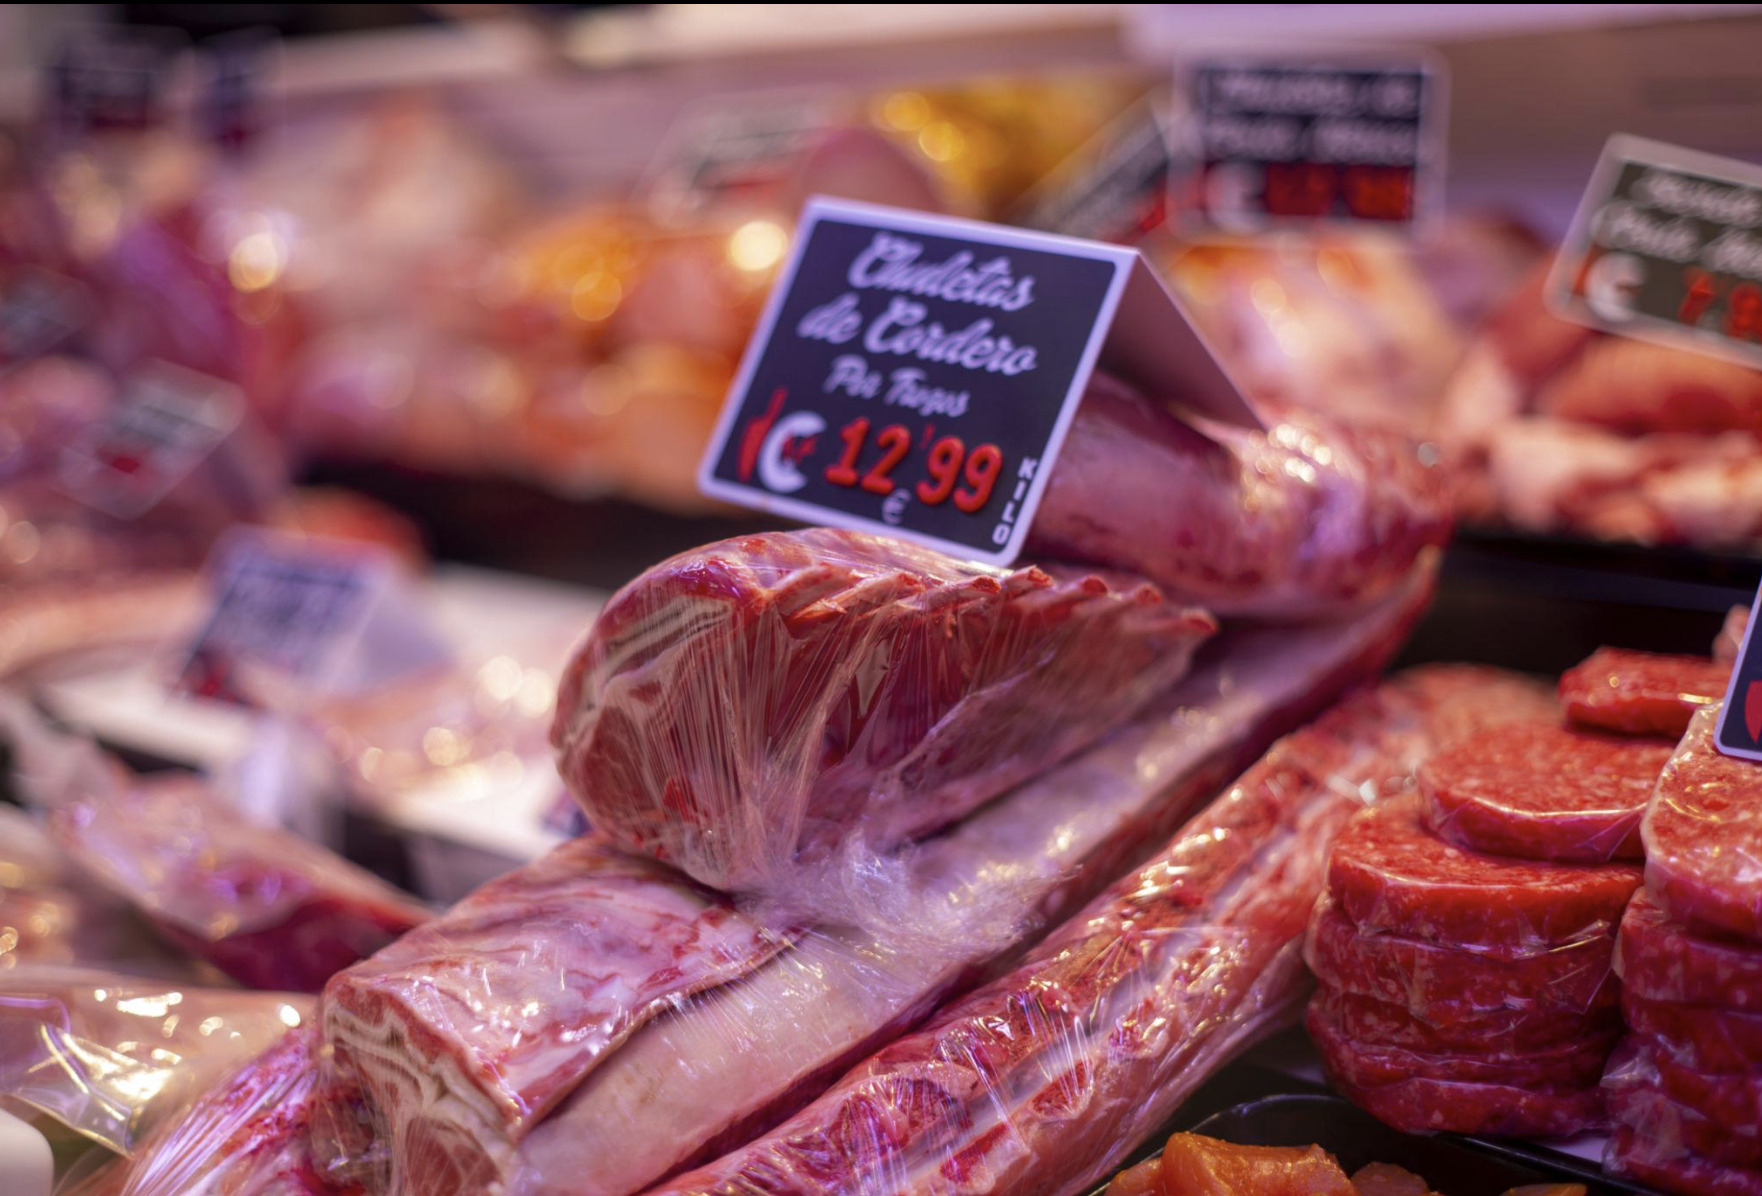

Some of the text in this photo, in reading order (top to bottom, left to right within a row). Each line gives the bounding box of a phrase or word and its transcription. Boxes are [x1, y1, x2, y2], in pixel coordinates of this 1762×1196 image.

[797, 293, 1038, 375] de Cordero
[824, 416, 1003, 514] 12'99
[992, 456, 1038, 546] KILO
